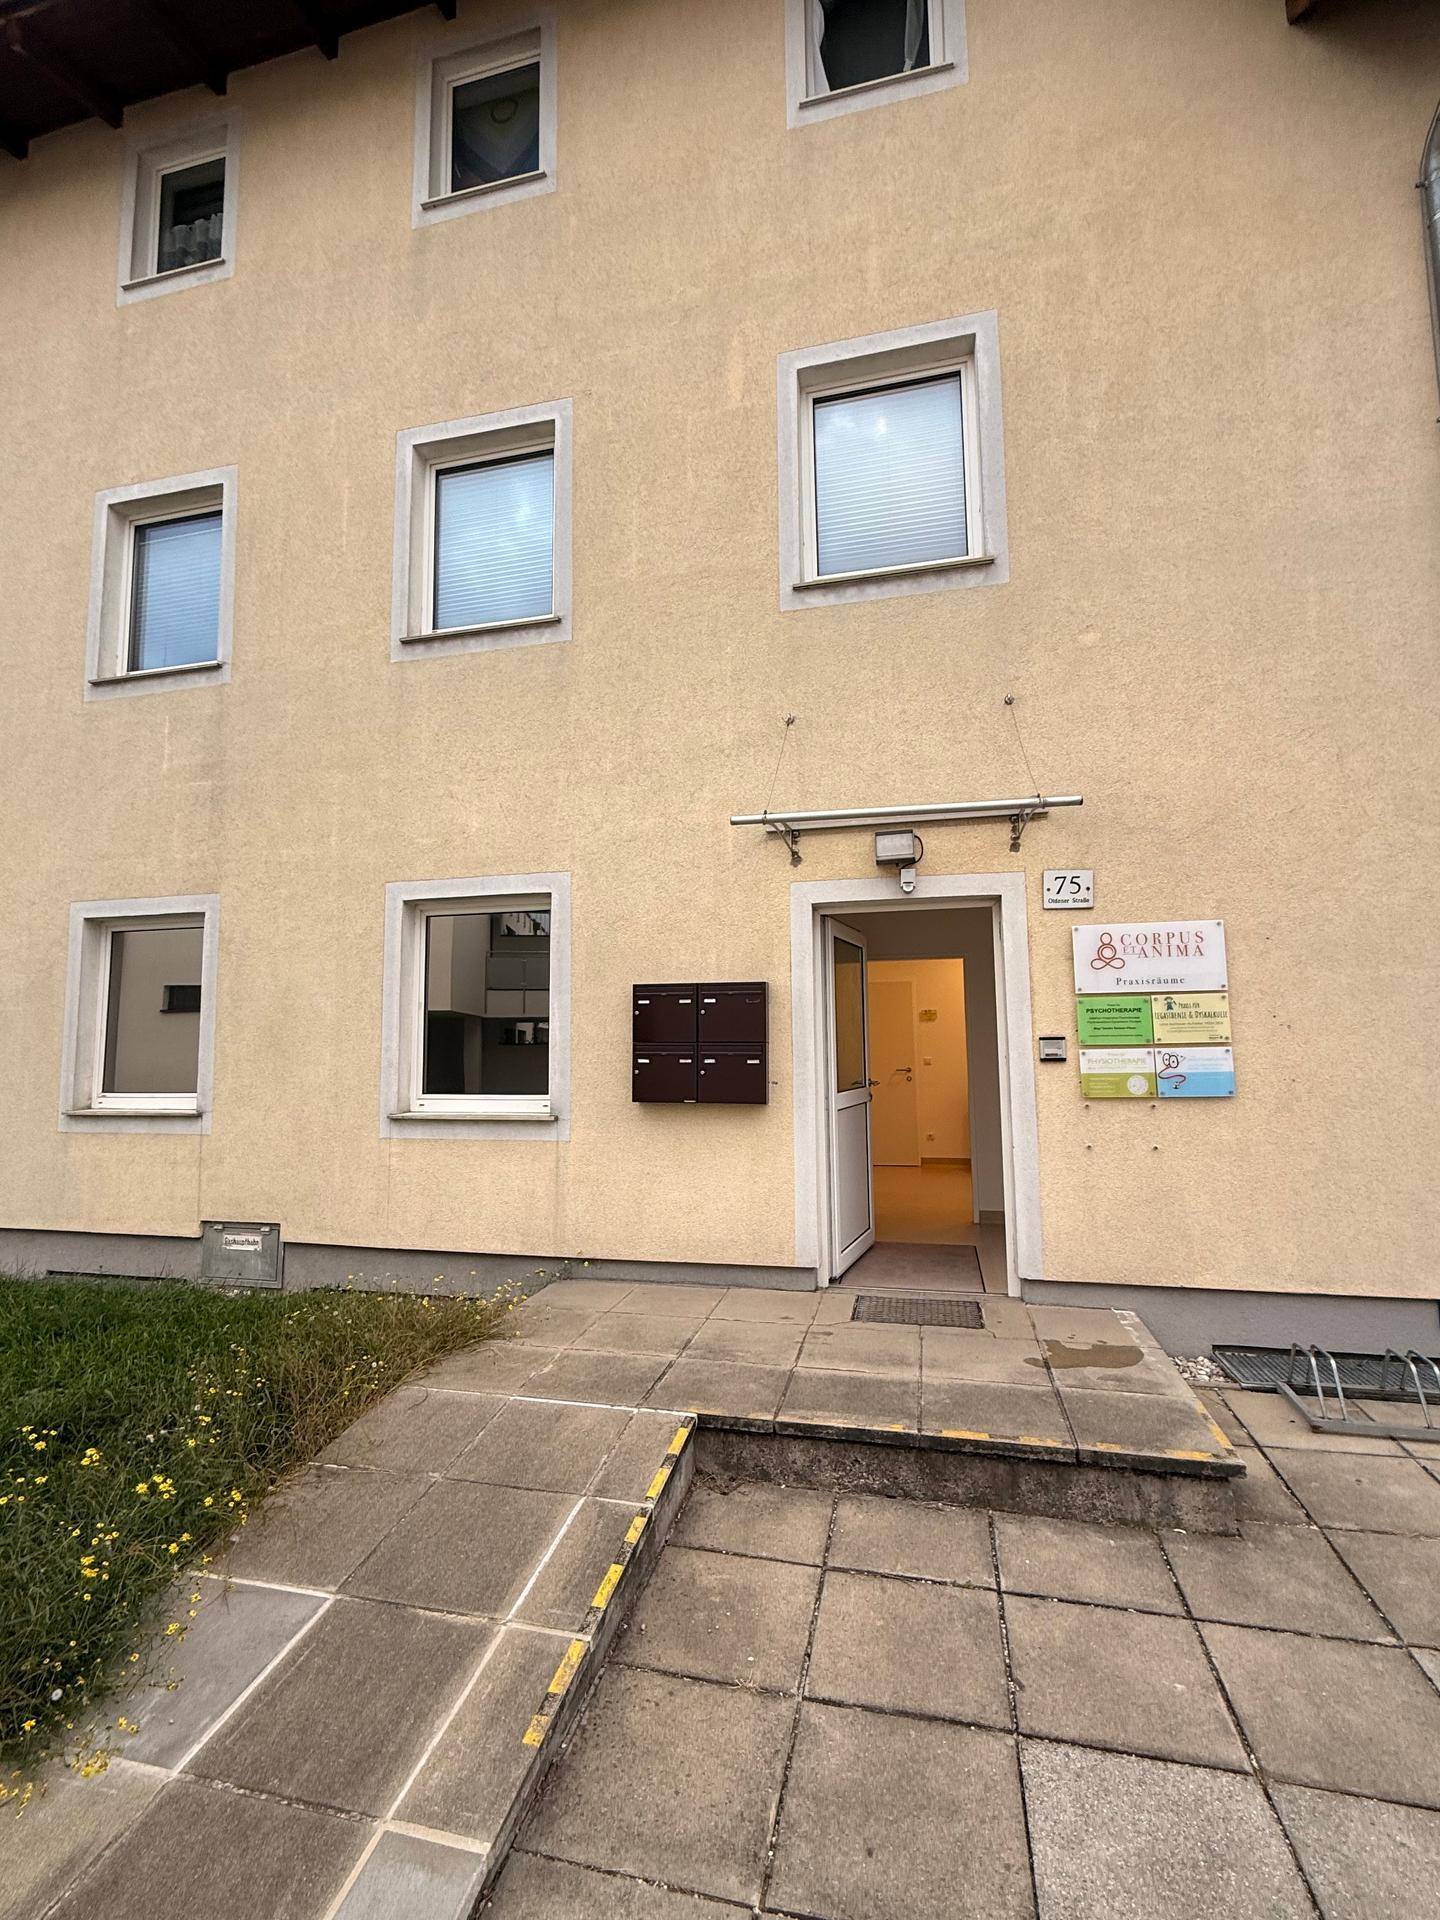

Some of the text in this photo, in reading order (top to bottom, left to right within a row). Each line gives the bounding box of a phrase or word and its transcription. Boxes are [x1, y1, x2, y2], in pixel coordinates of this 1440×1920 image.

[1054, 875, 1081, 895] 75
[1120, 930, 1204, 946] CORPUS
[1123, 944, 1205, 958] ET ANIMA
[1116, 976, 1185, 986] Praxisräume
[1188, 1011, 1194, 1019] &
[1087, 1057, 1146, 1065] PHYSIOTHERAPIE
